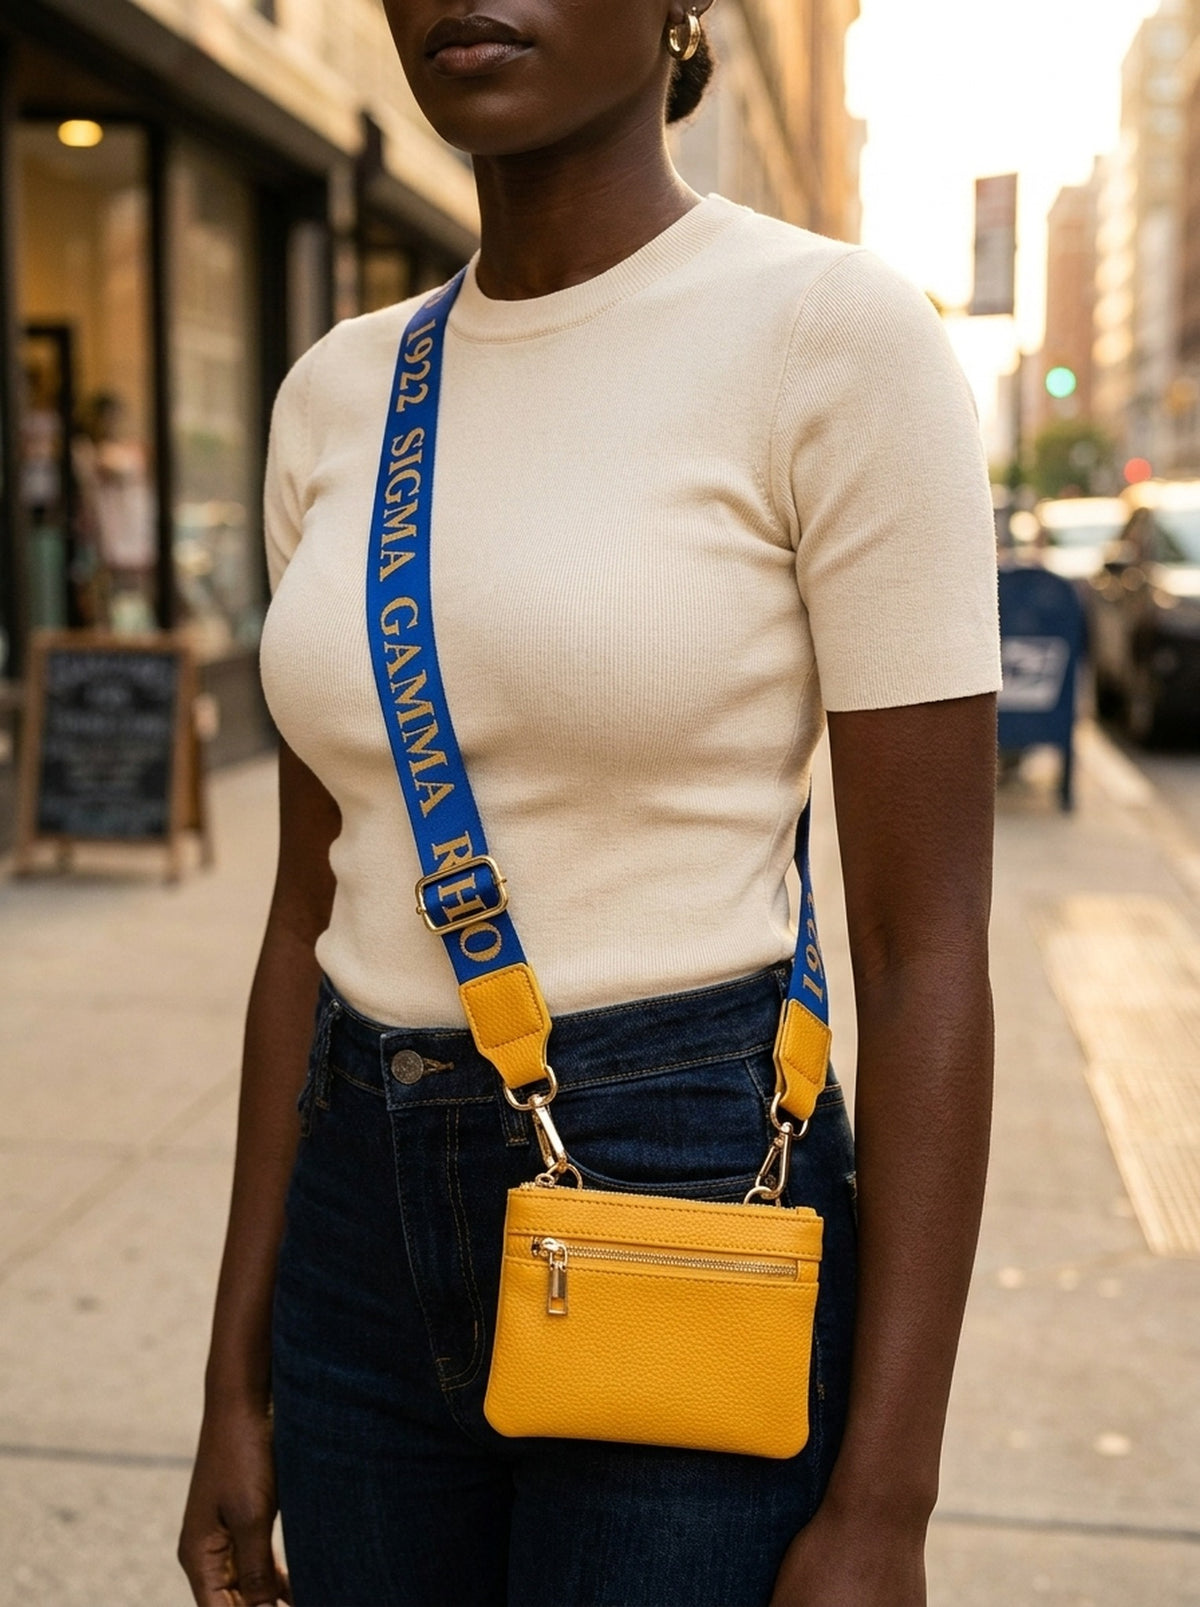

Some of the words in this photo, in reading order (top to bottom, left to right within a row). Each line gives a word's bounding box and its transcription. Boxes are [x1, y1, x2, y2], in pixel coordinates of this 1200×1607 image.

[396, 319, 436, 413] 1922
[379, 427, 425, 582] SIGMA
[380, 596, 455, 818] GAMMA
[431, 830, 502, 962] RHO
